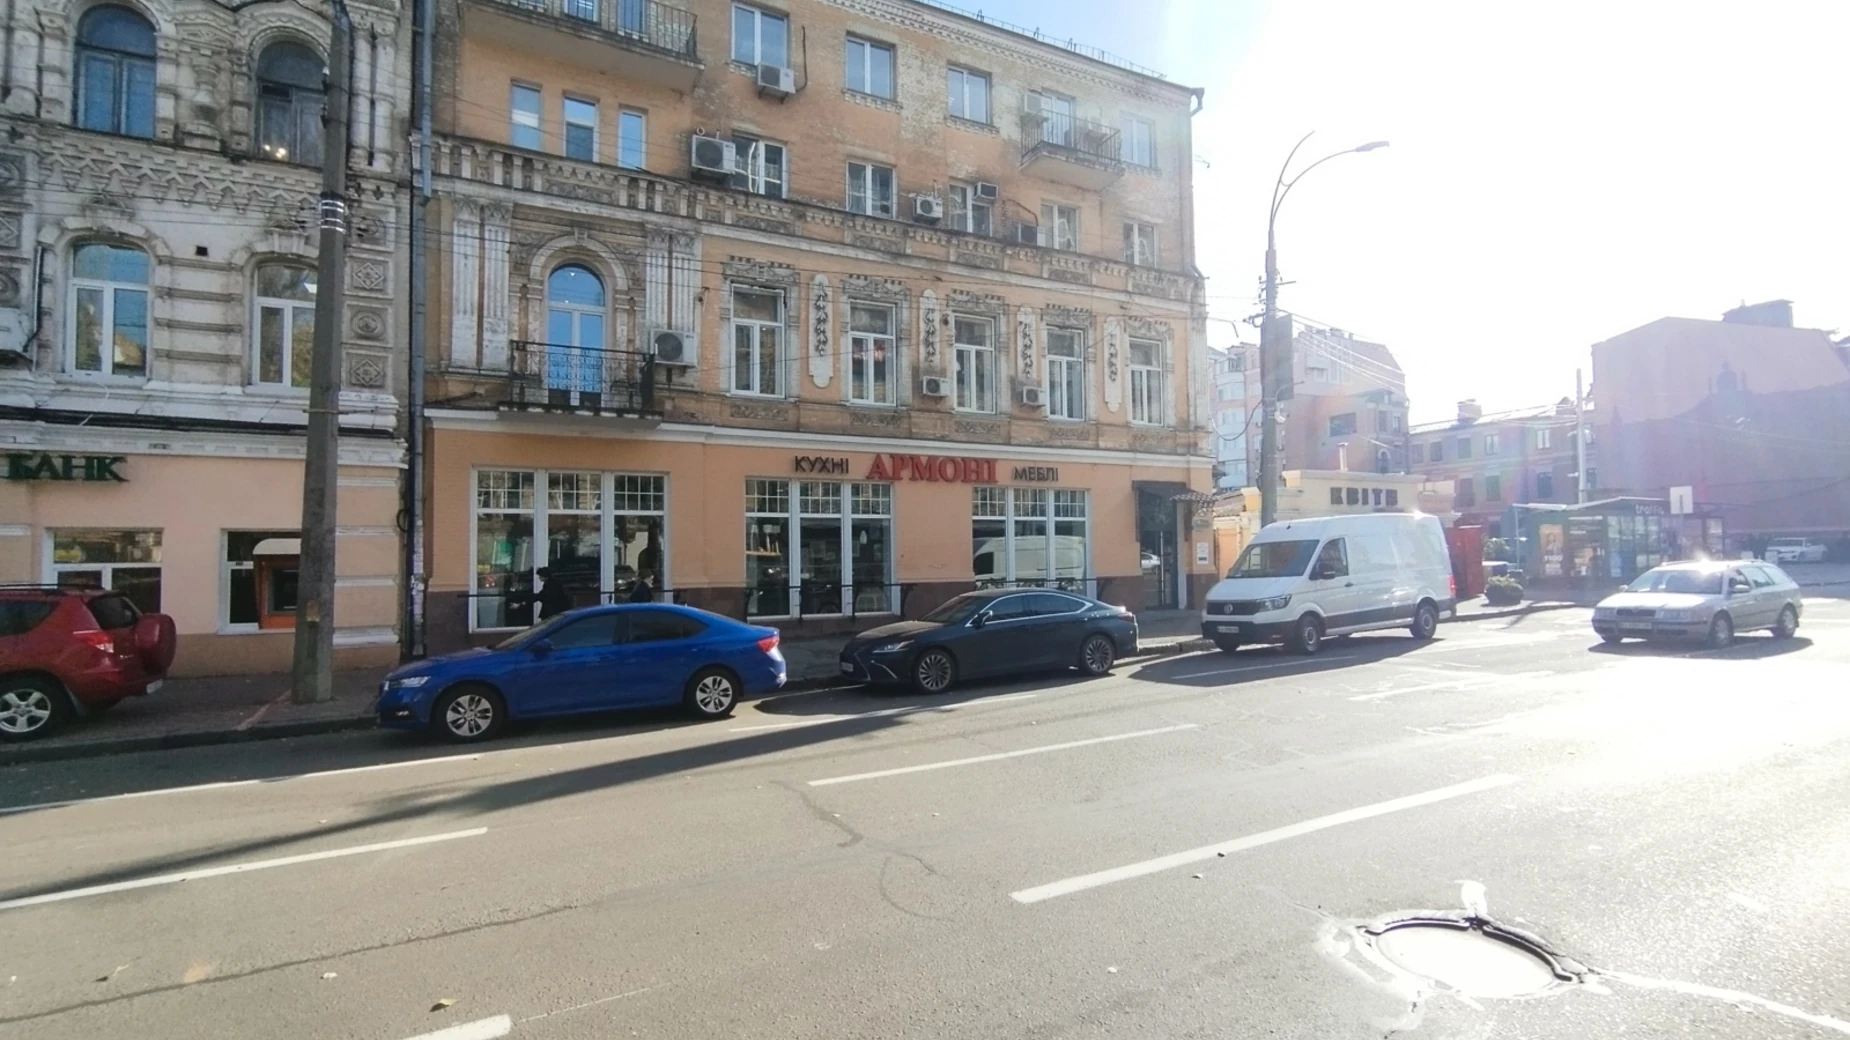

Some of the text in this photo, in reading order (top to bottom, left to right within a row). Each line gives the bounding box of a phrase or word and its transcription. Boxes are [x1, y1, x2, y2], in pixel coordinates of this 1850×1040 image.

[5, 453, 130, 483] БАНК
[794, 453, 1060, 483] КУХНІ АРМОНІ МЕБЛІ
